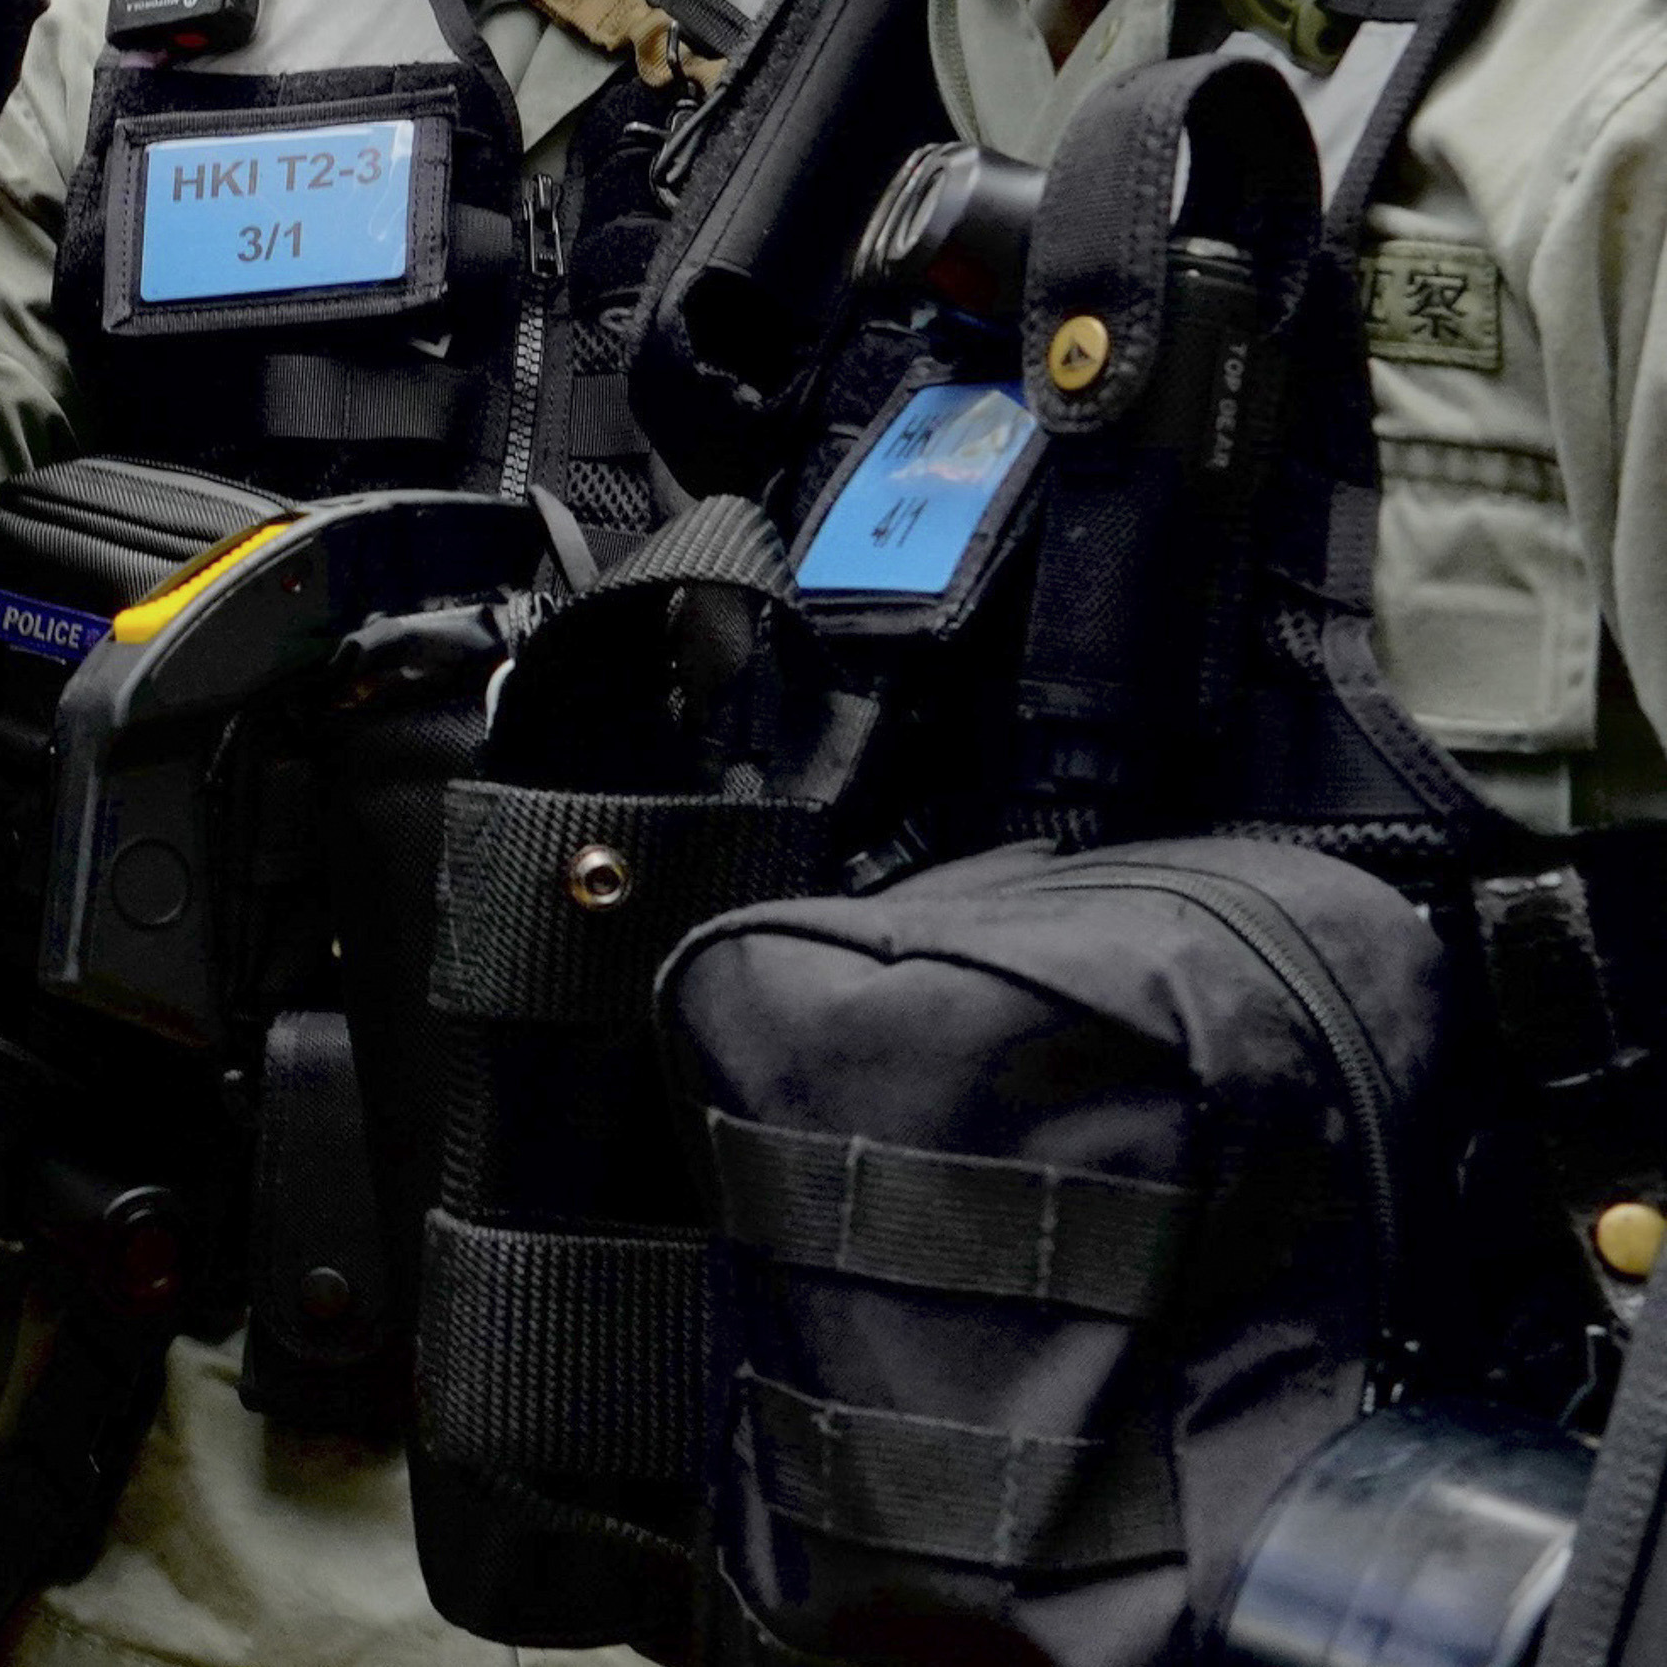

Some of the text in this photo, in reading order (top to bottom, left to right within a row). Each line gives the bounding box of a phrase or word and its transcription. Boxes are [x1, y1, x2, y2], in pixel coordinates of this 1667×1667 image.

[172, 147, 383, 202] HKI T2-3
[237, 220, 303, 262] 3/1
[2, 605, 84, 651] POLICE
